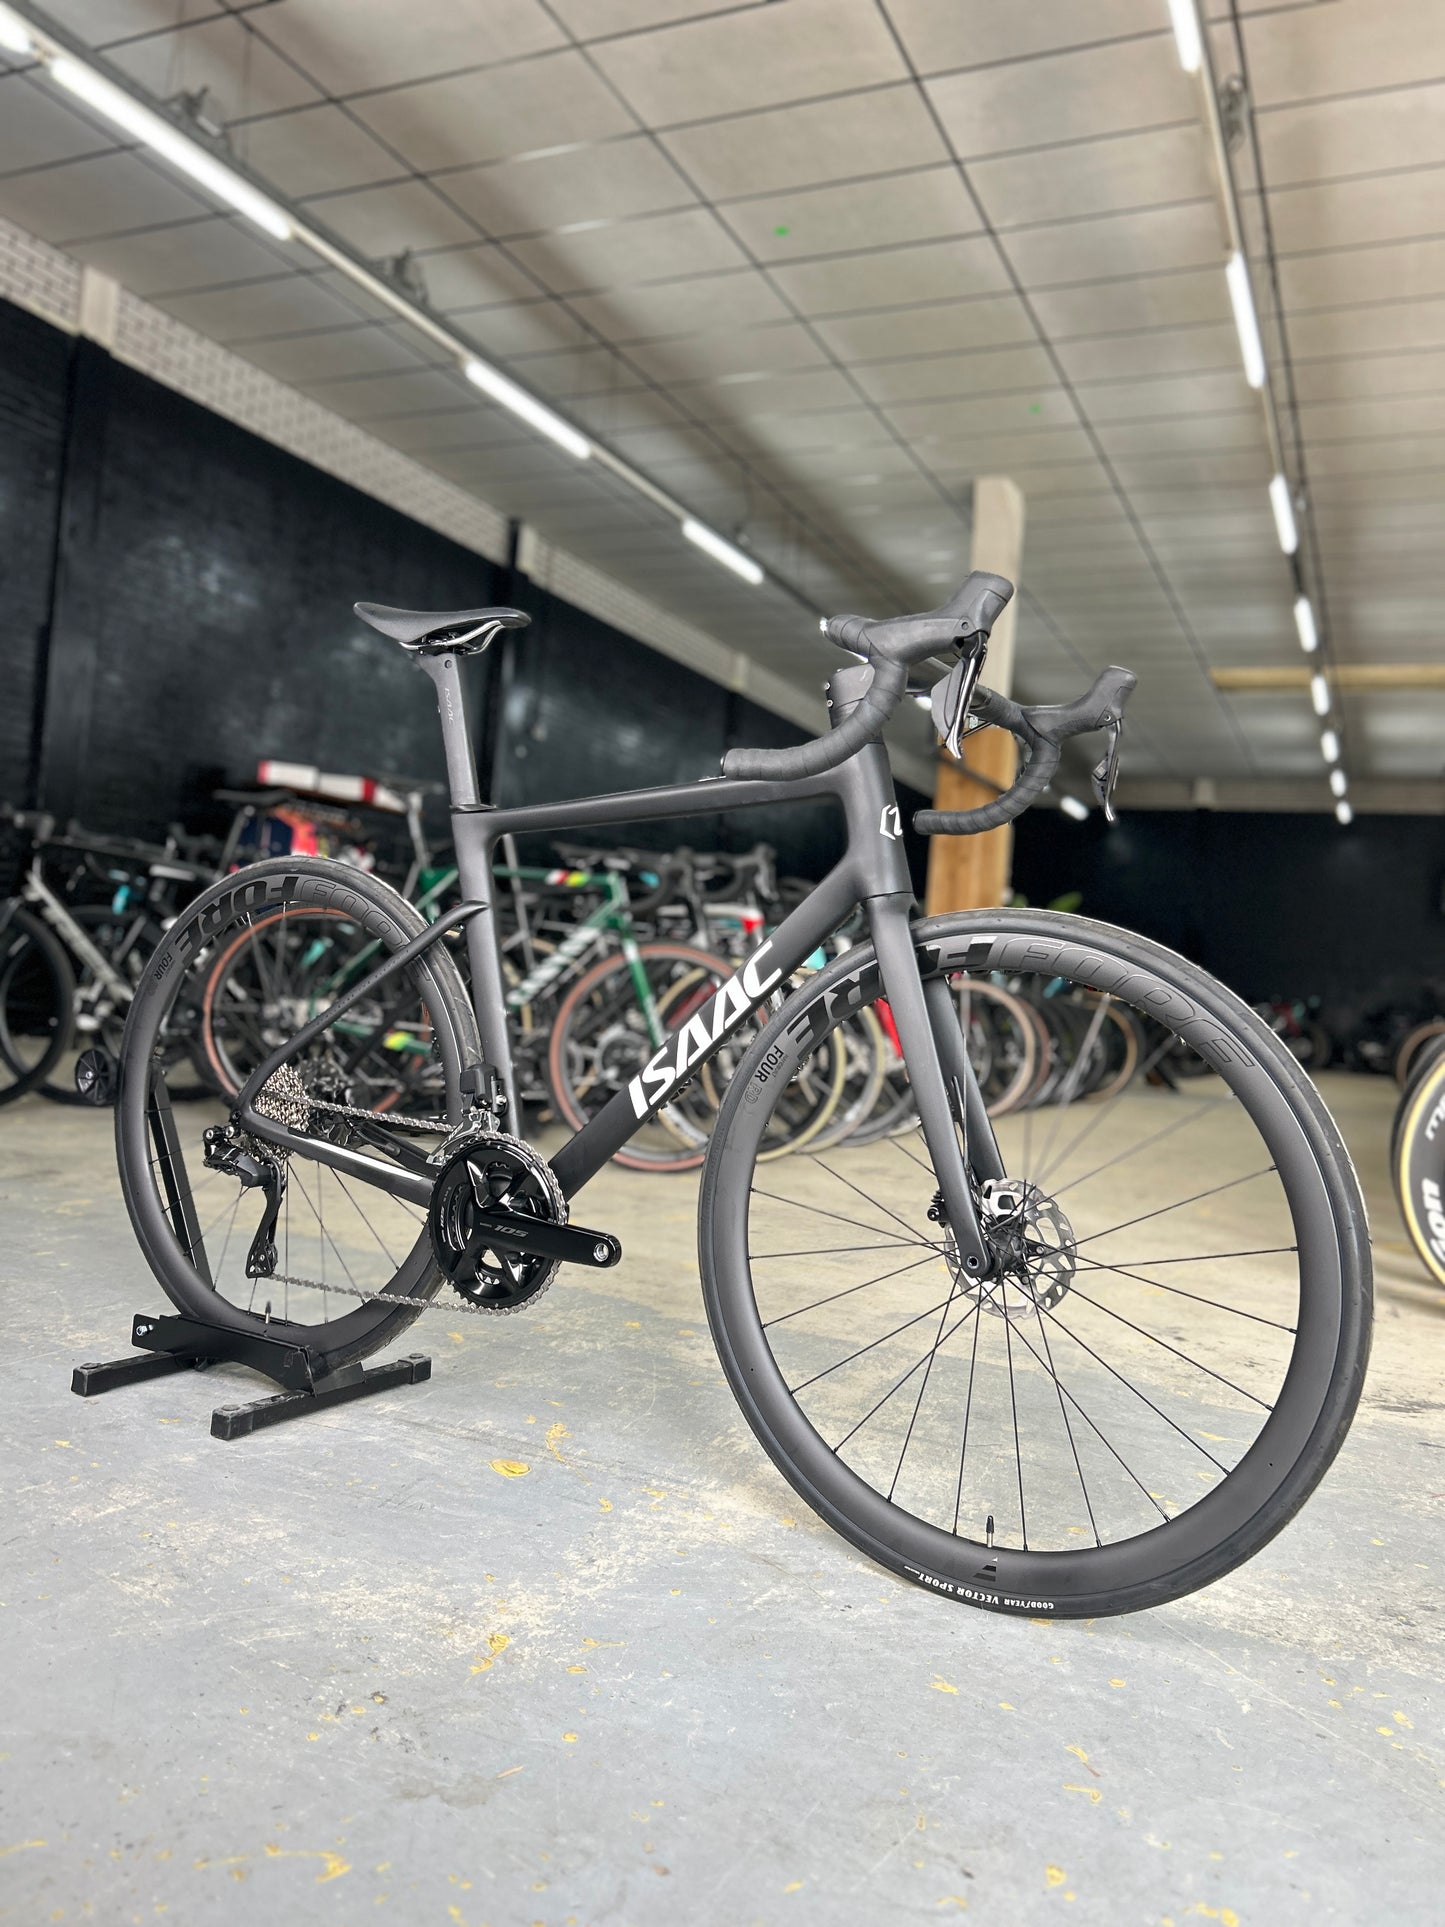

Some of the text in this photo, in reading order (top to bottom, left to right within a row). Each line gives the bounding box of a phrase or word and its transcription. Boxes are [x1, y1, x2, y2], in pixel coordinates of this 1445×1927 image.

[175, 876, 299, 967] FORE
[154, 952, 173, 981] FOUR
[628, 940, 782, 1120] ISAAC
[754, 1045, 785, 1084] FOUR
[494, 1224, 529, 1238] 105
[917, 1573, 1055, 1610] GOODYEAR VECTOR SPORT
